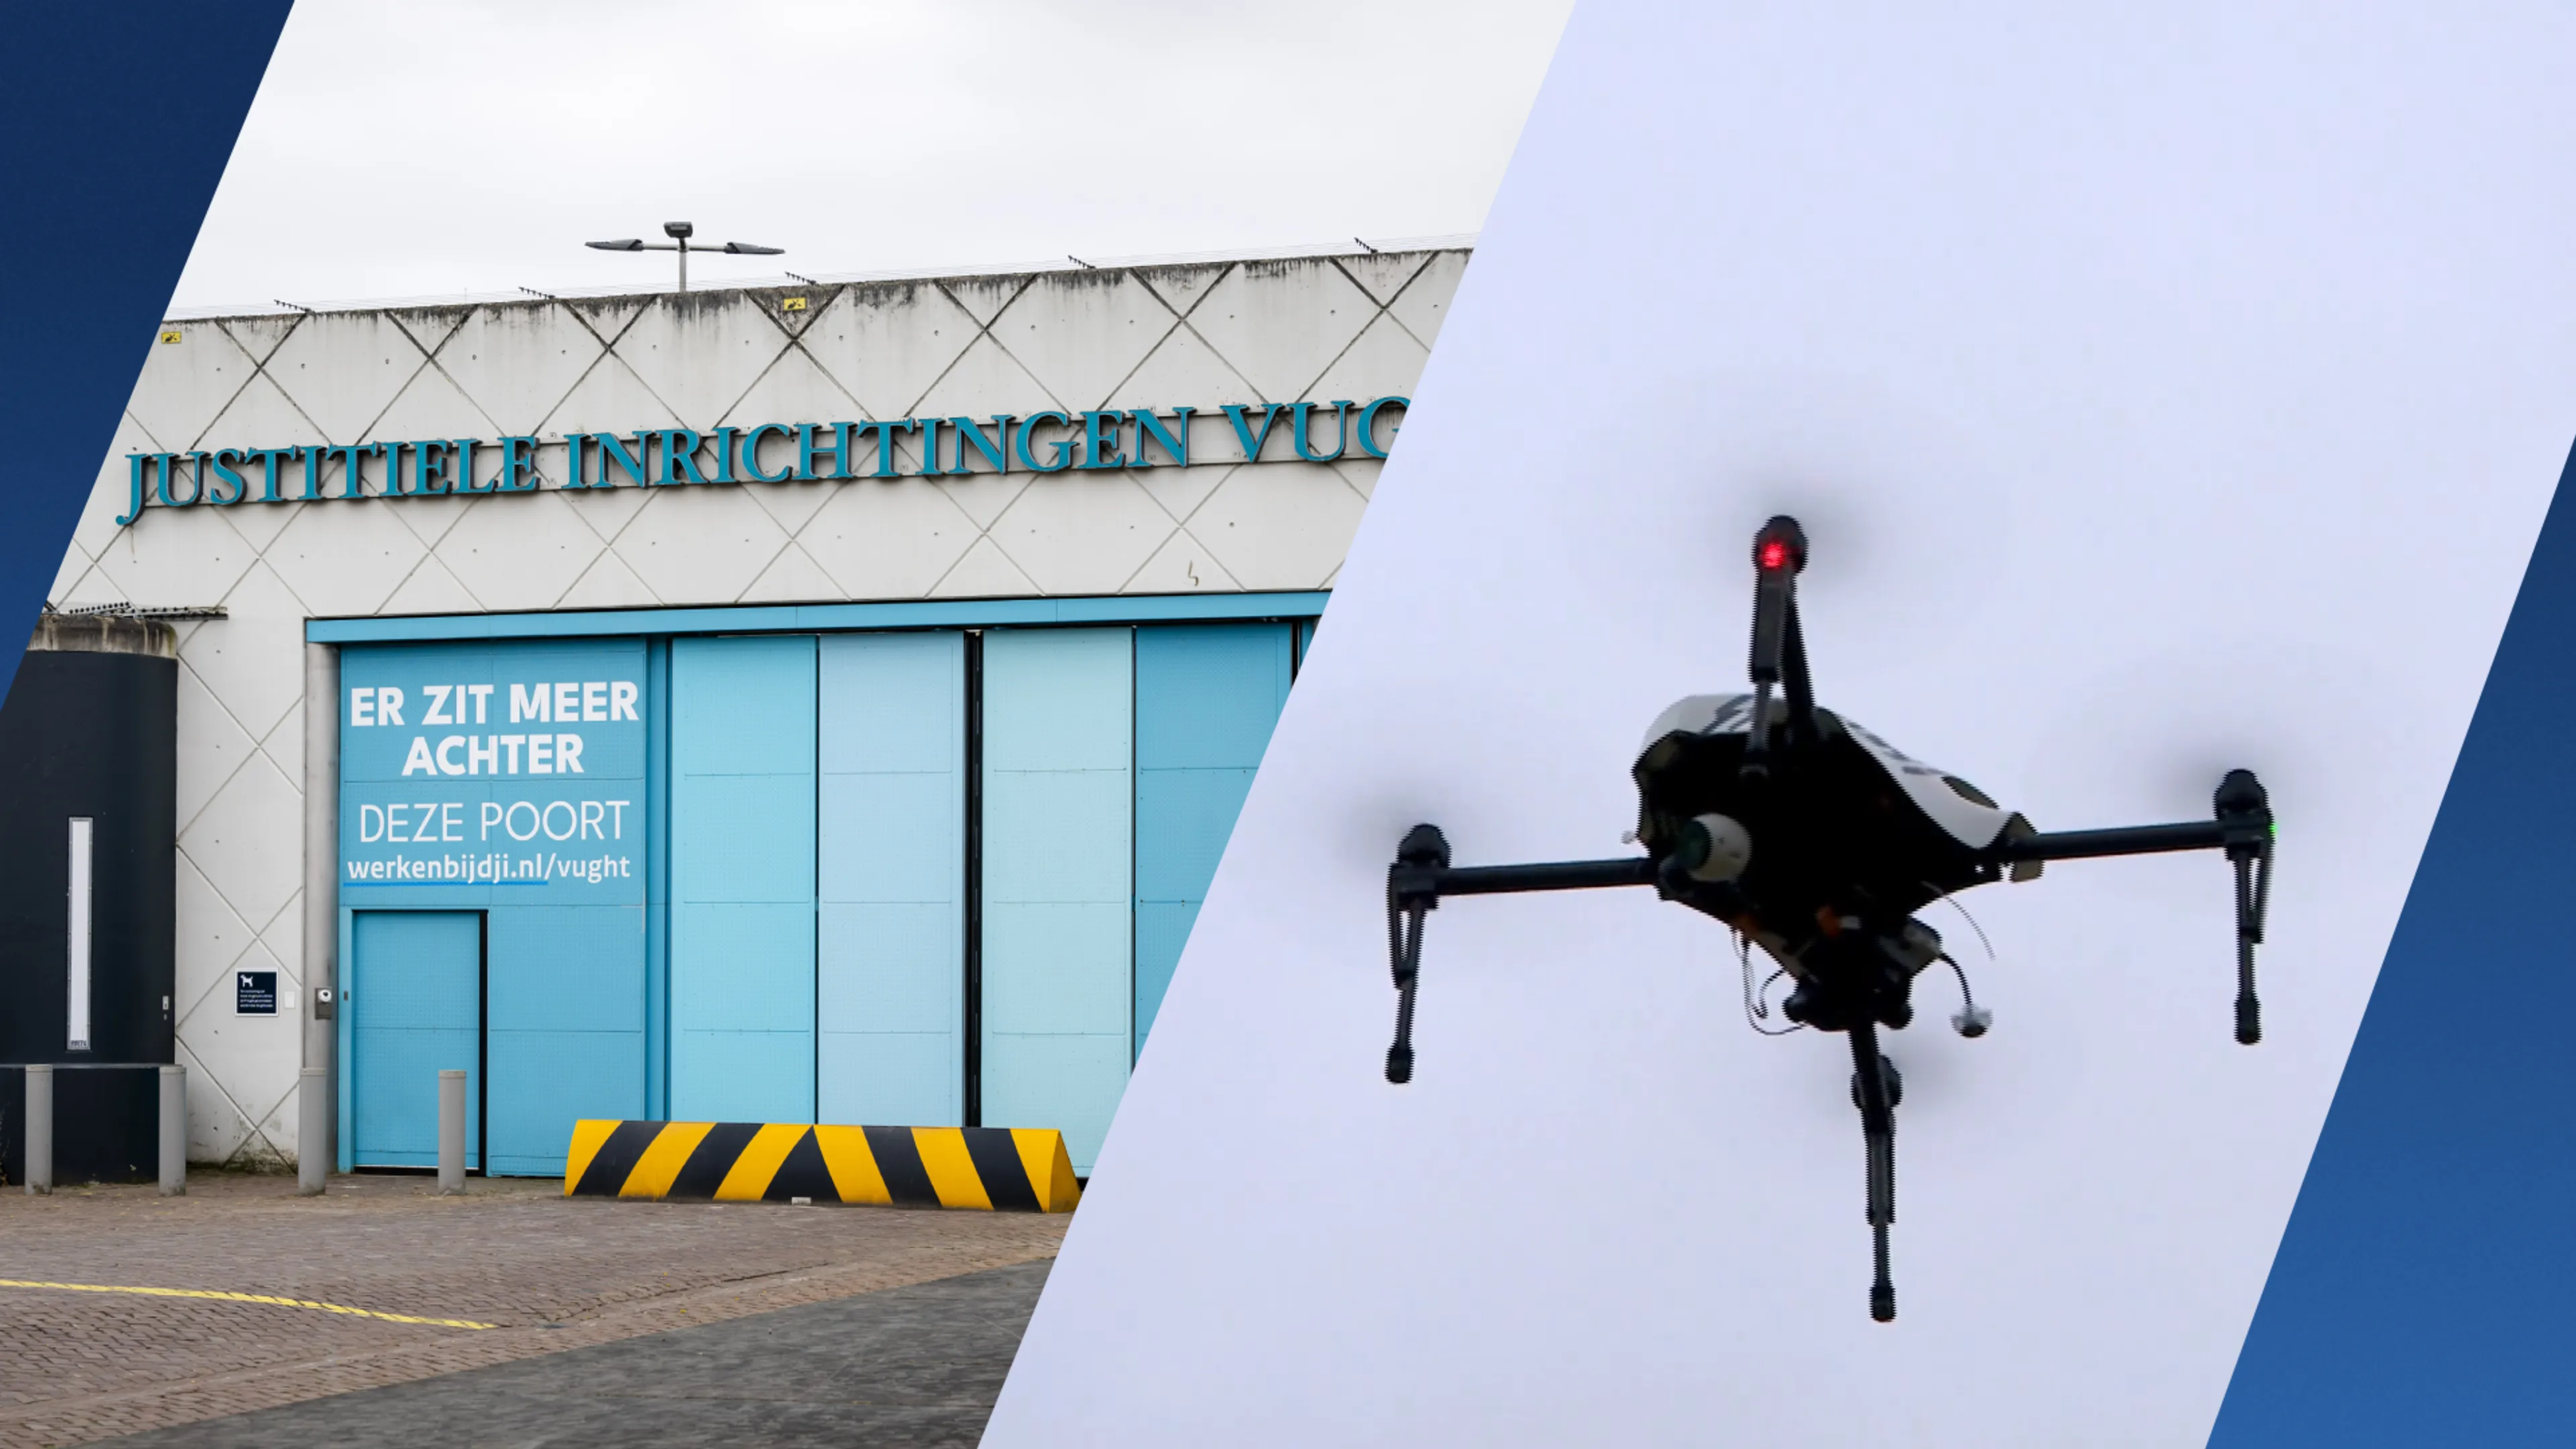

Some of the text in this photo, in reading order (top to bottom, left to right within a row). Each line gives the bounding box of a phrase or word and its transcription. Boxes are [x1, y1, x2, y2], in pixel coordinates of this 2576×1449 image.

[115, 435, 540, 525] JUSTITIELE
[561, 407, 1197, 489] INRICHTINGEN
[351, 681, 639, 727] ER ZIT MEER
[401, 734, 584, 776] ACHTER
[360, 800, 630, 843] DEZE POORT
[347, 853, 631, 884] werkenbijdji.nl/vught
